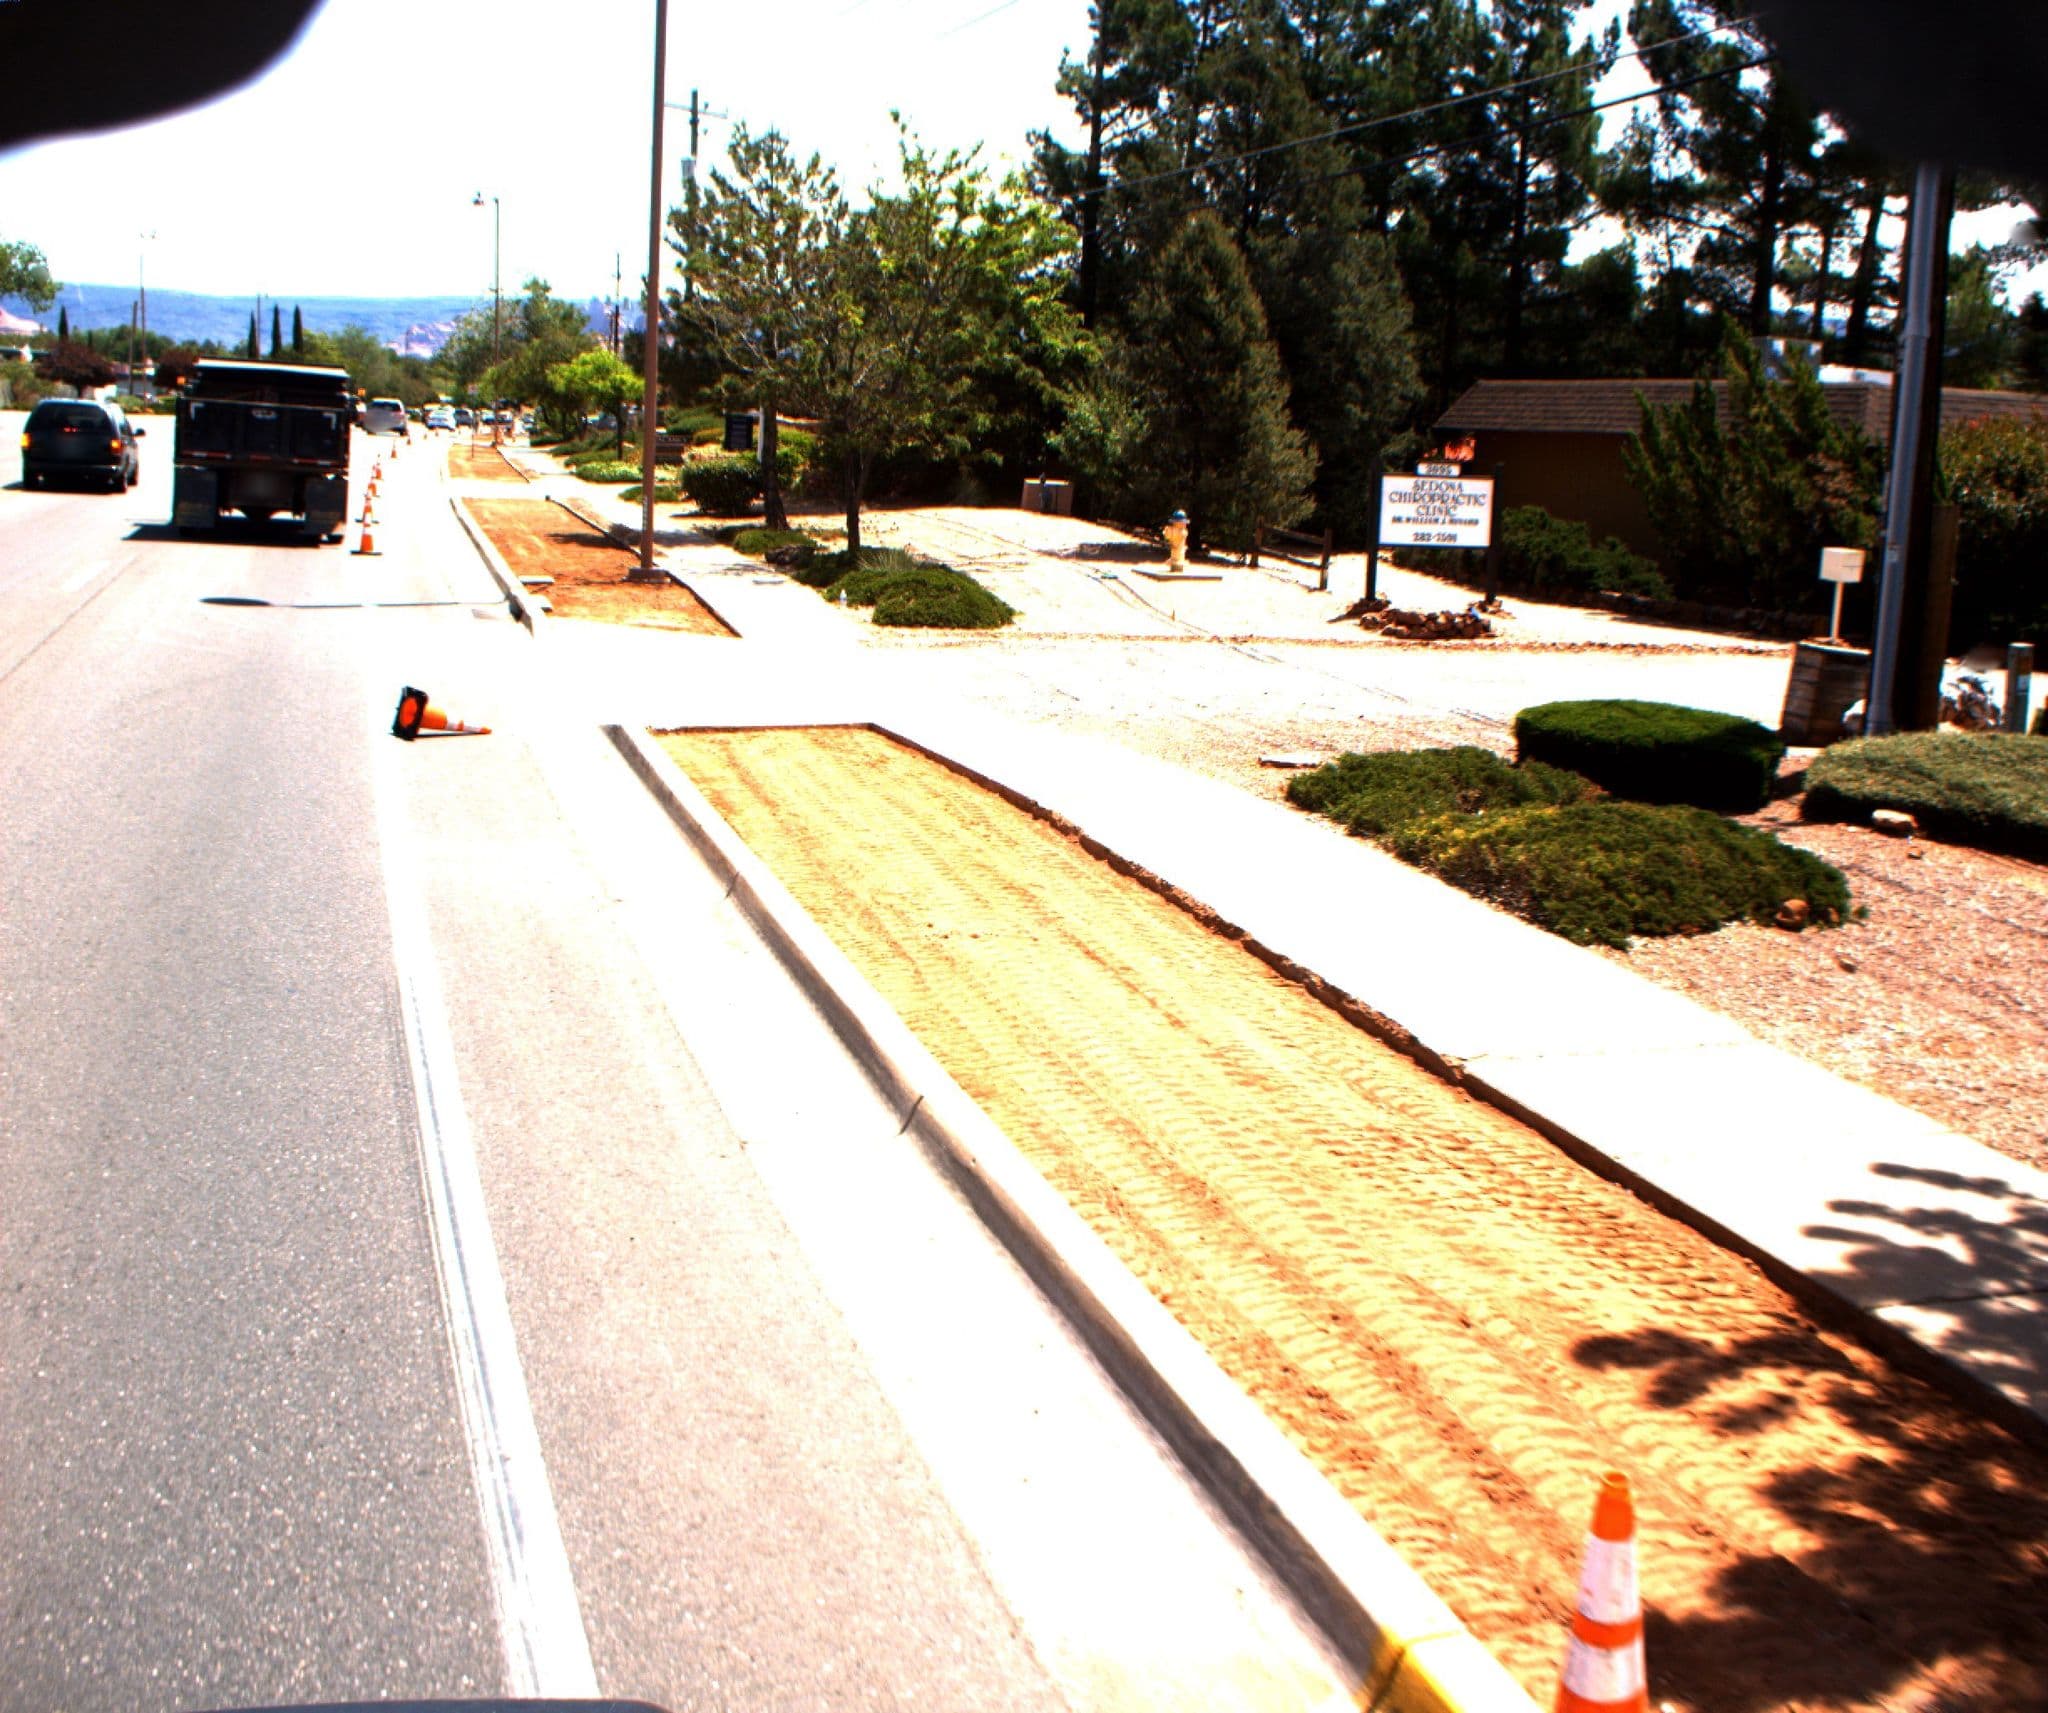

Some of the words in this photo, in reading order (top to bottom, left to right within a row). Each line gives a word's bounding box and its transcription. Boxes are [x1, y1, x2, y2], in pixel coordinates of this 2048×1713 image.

[1412, 480, 1464, 493] SEDONA
[1388, 491, 1488, 506] CHIROPRACTIC
[1416, 504, 1458, 517] CLINIC
